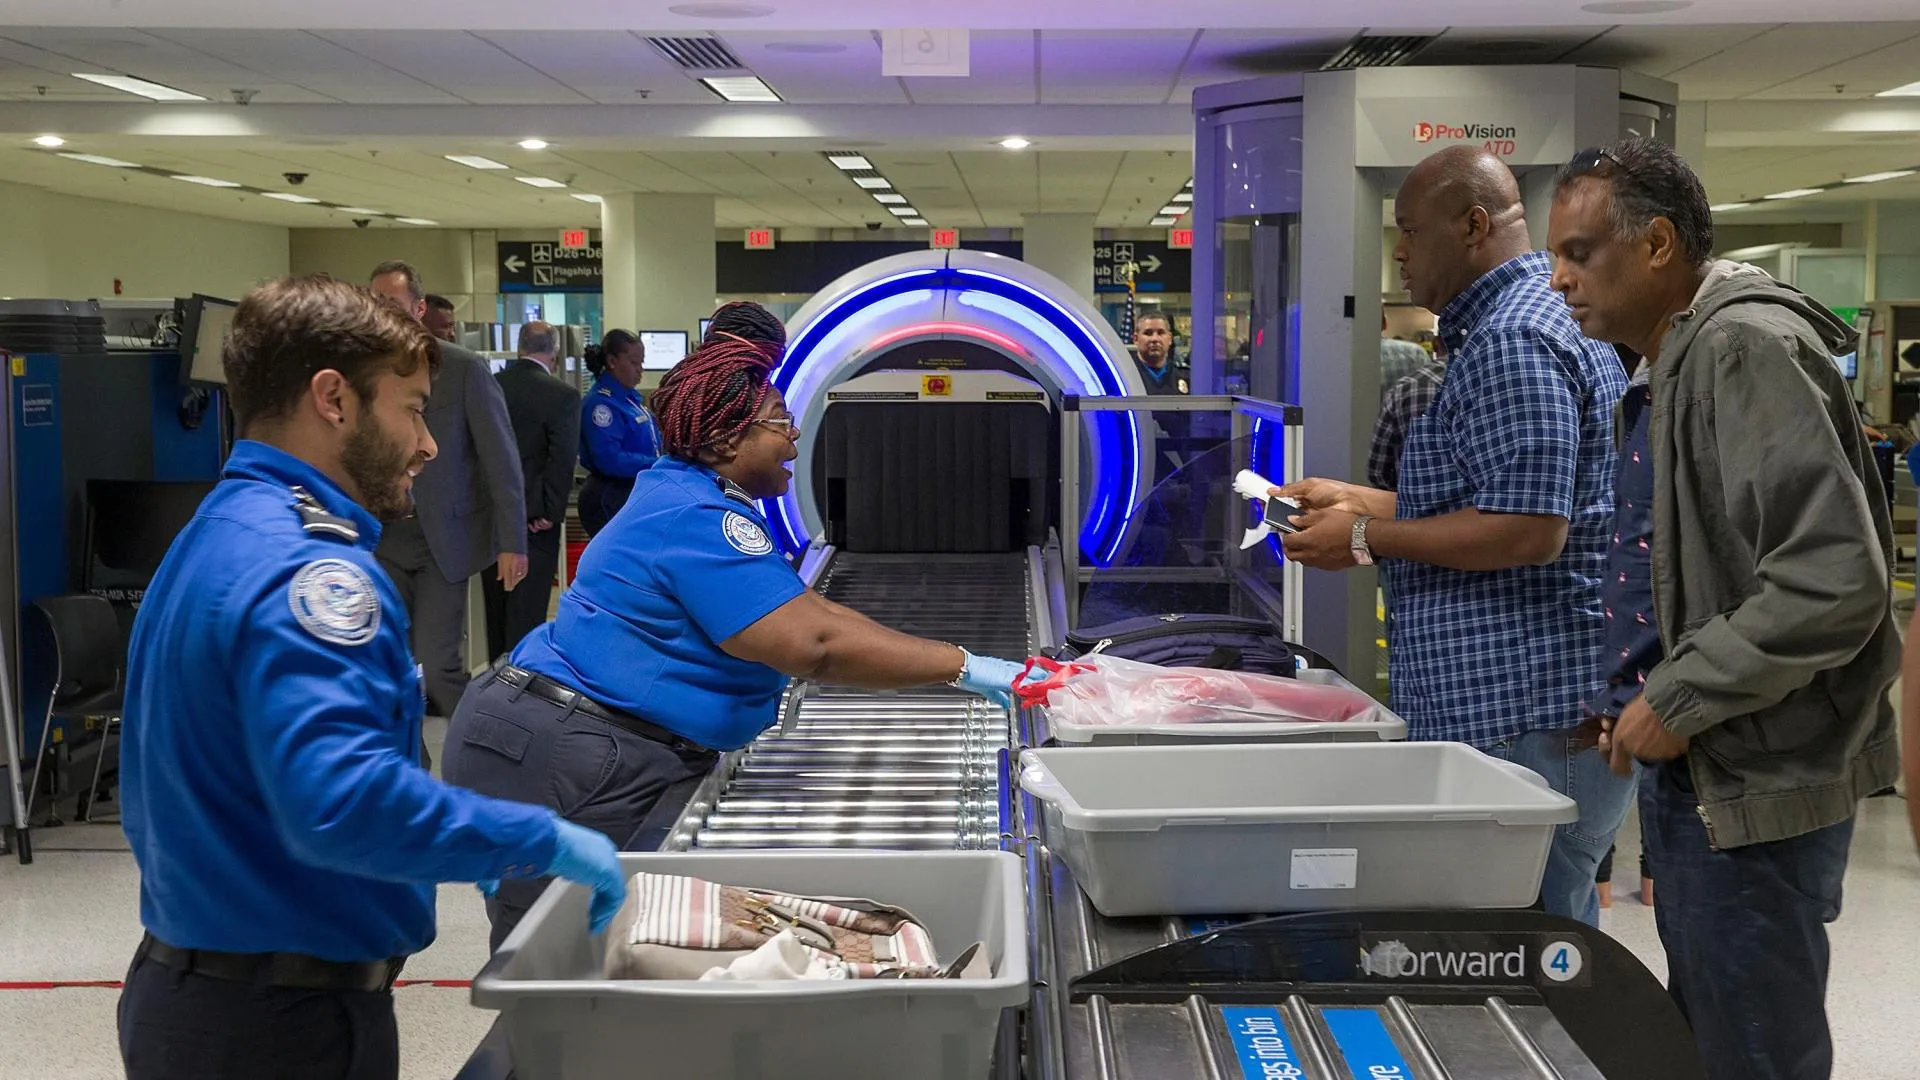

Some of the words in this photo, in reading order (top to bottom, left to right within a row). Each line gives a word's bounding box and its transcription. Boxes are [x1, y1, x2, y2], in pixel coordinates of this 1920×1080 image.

[1436, 124, 1516, 140] ProVision
[1483, 140, 1516, 156] ATD
[563, 231, 585, 247] EXIT
[749, 231, 769, 246] EXIT
[934, 231, 955, 246] EXIT
[554, 266, 592, 277] Flagship
[1550, 948, 1569, 973] 4
[1238, 1016, 1278, 1035] bin
[1248, 1036, 1289, 1060] into
